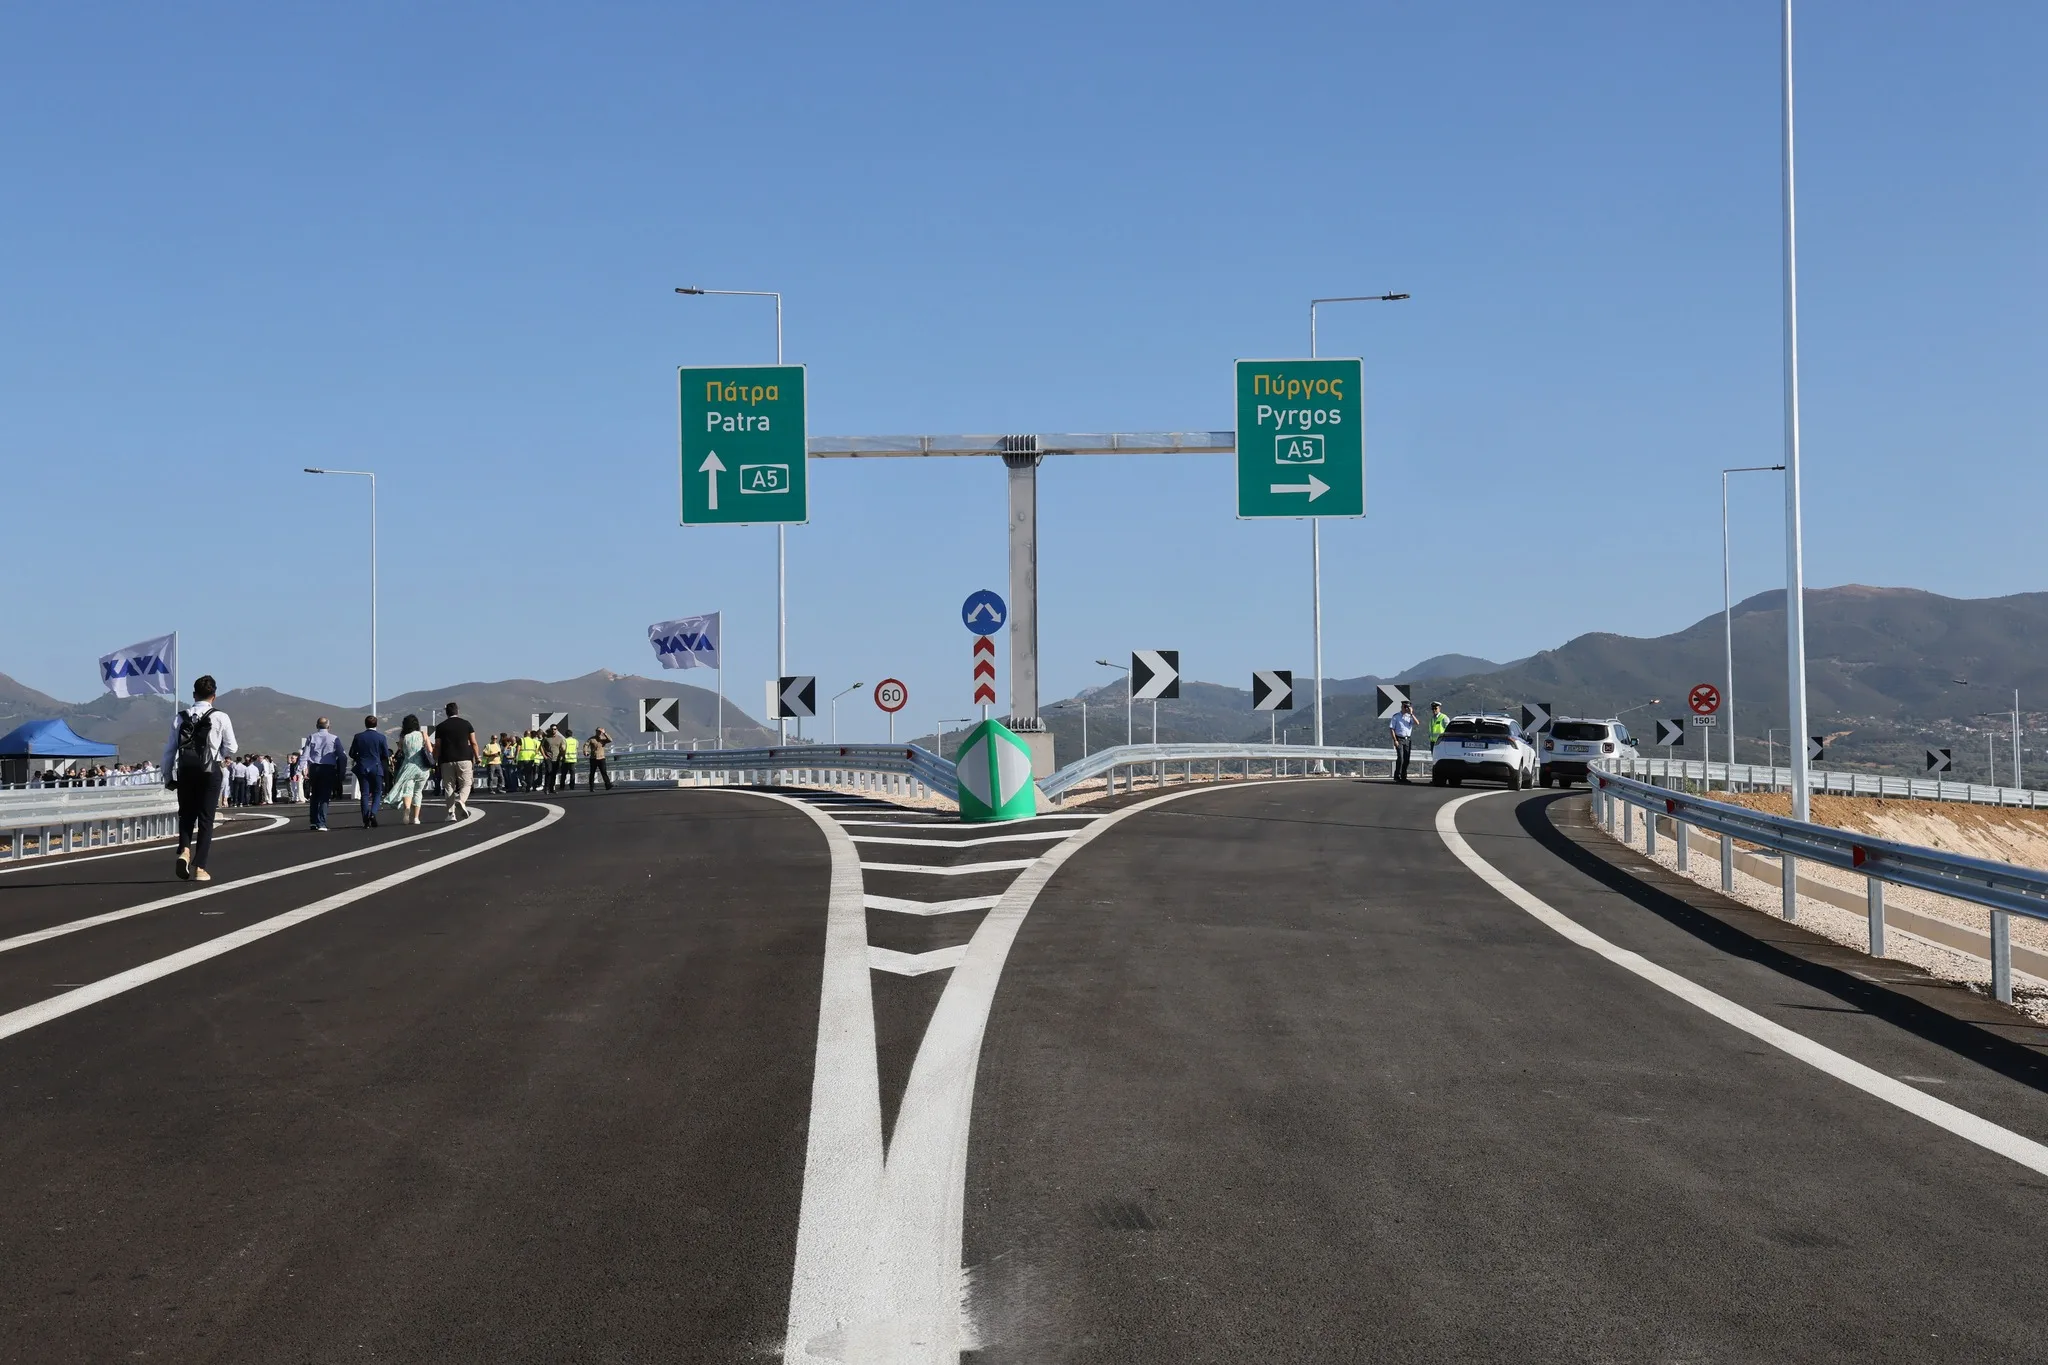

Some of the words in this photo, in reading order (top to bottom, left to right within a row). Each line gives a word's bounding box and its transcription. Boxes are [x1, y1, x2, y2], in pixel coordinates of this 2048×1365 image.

[706, 380, 779, 407] Πάτρα
[1253, 374, 1344, 401] Πύργος
[707, 411, 770, 432] Patra
[1257, 404, 1342, 430] Pyrgos
[1287, 440, 1313, 458] A5
[752, 470, 778, 488] A5
[882, 688, 901, 702] 60
[1694, 716, 1710, 724] 150
